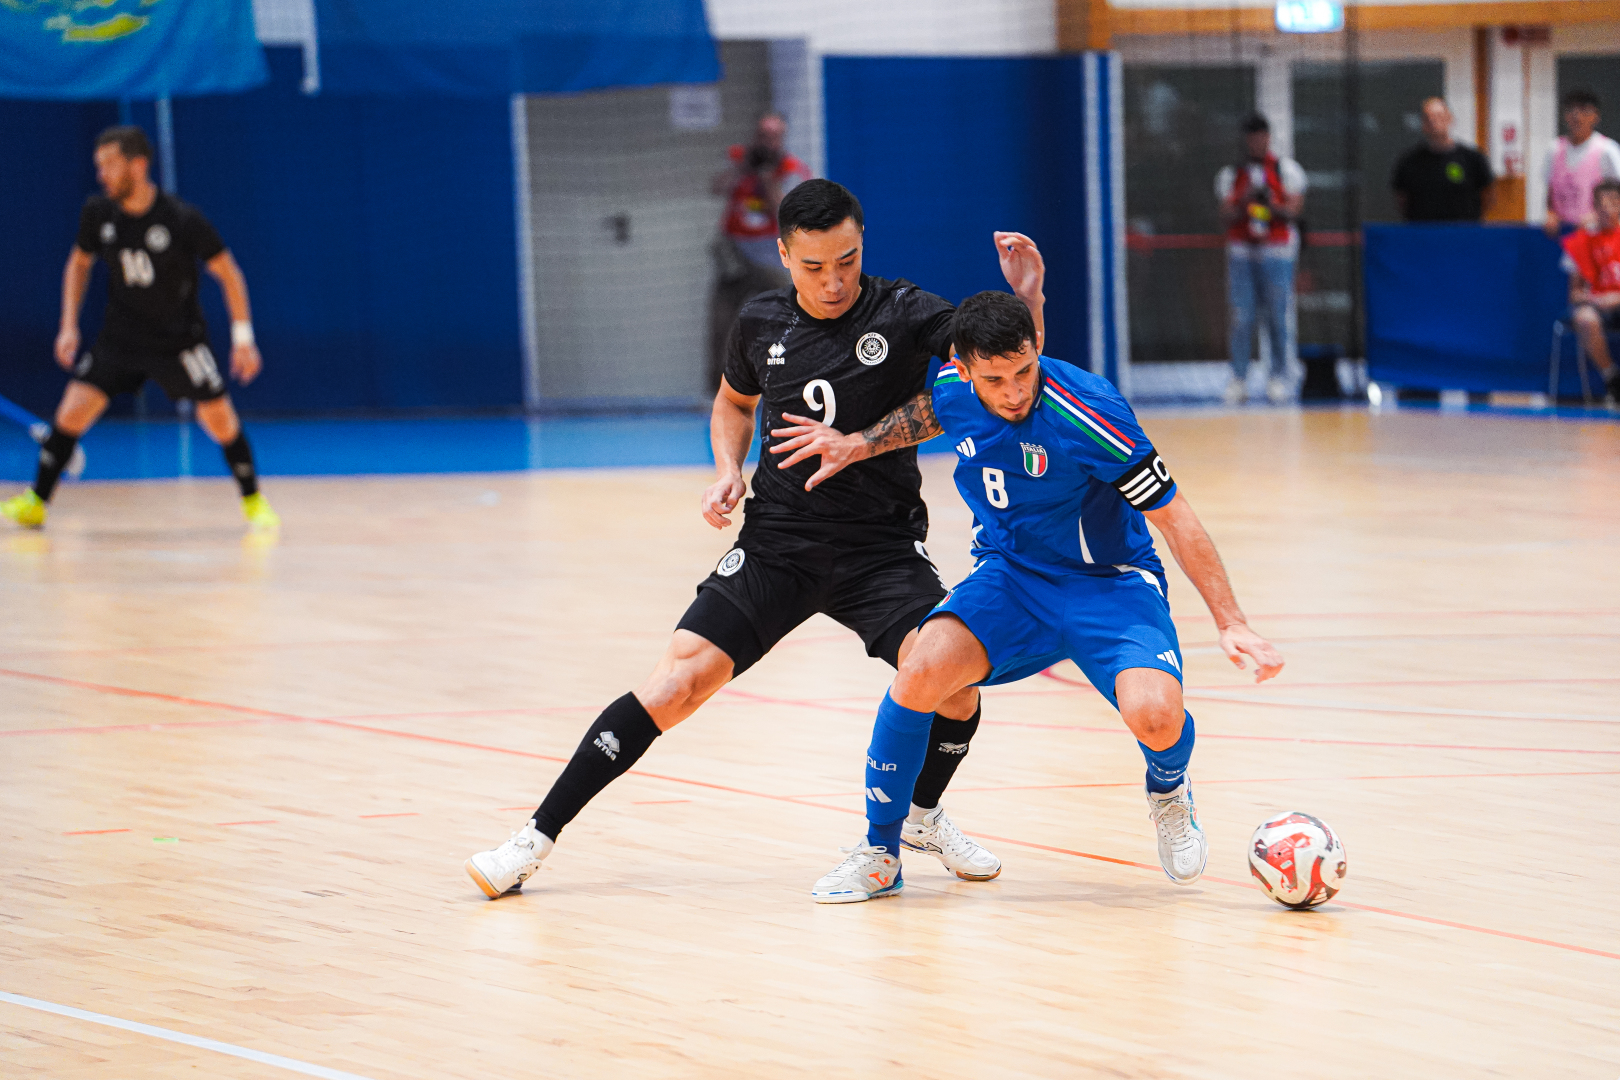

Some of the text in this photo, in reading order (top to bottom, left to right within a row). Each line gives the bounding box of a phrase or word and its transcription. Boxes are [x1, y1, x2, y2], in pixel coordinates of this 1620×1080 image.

[802, 378, 837, 428] 9
[982, 467, 1010, 509] 8
[867, 755, 898, 771] ALIA
